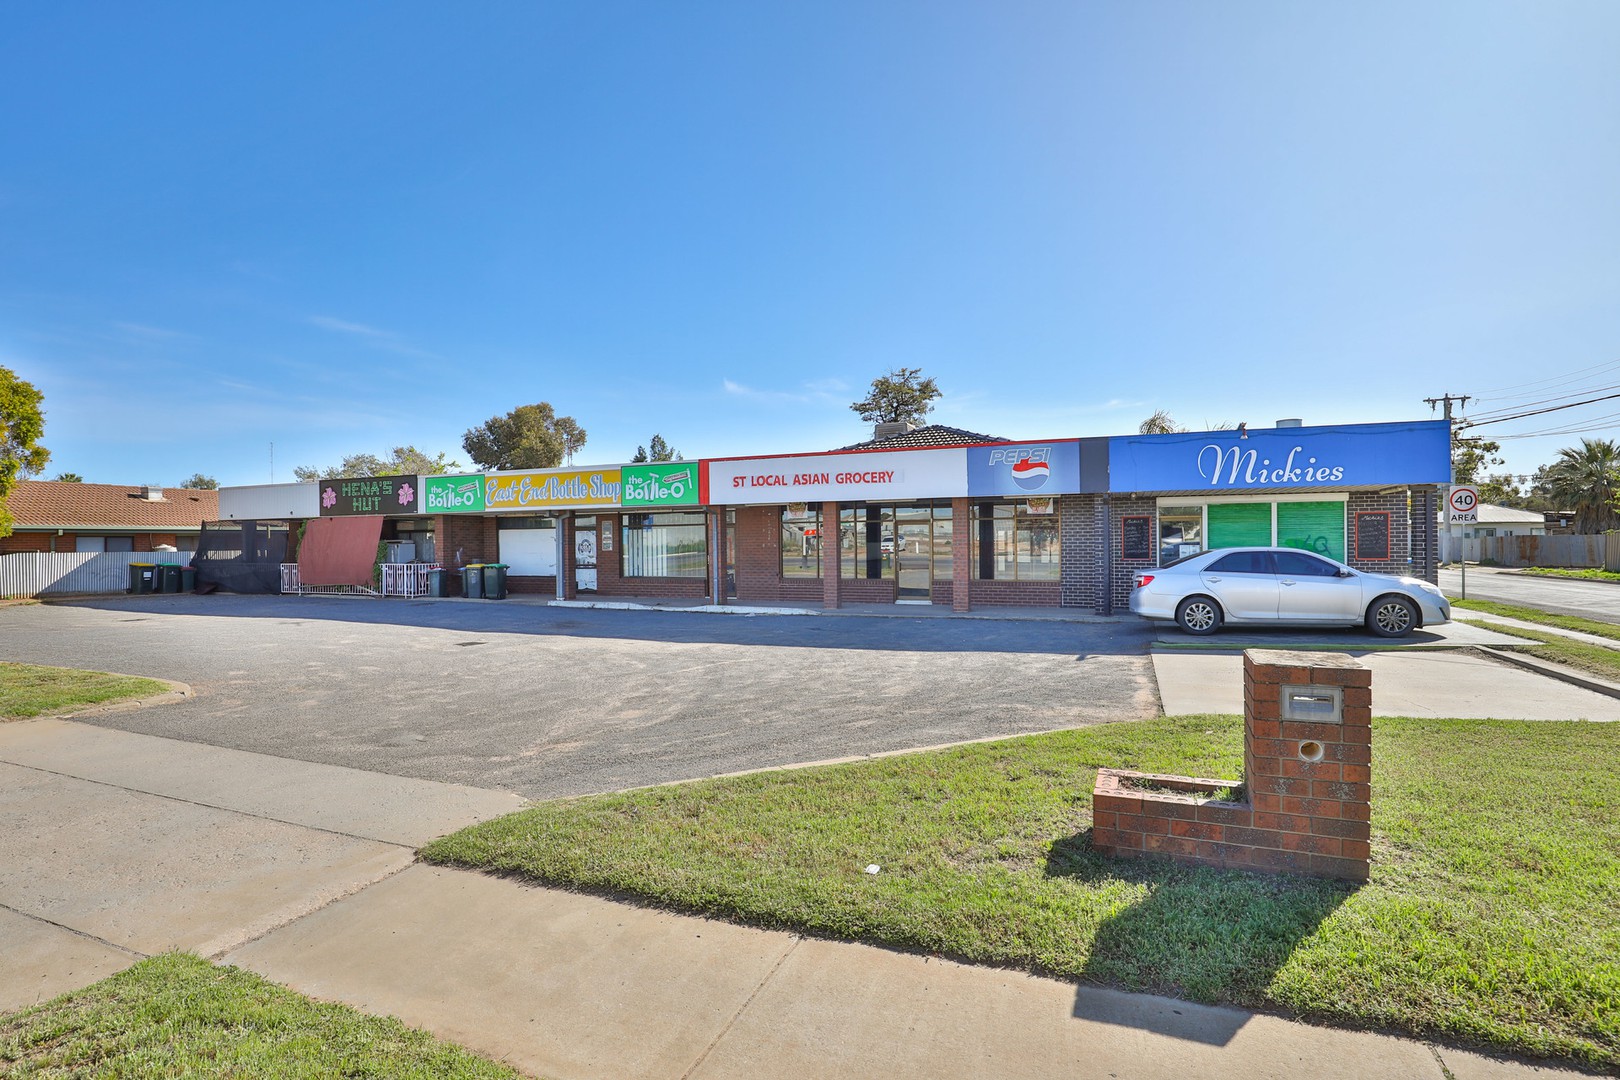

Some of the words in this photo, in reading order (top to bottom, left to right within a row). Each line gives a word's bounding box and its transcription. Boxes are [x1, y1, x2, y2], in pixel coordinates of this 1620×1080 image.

[989, 447, 1053, 466] PEPSI
[1197, 444, 1345, 485] Mickies
[628, 475, 643, 485] the
[733, 475, 746, 488] ST
[751, 474, 788, 487] LOCAL
[793, 473, 830, 486] ASIAN
[835, 470, 895, 485] GROCERY
[342, 481, 393, 496] HENA'S
[431, 485, 442, 494] the
[485, 478, 519, 504] East
[519, 476, 551, 506] End
[551, 475, 588, 500] Bottle
[589, 474, 621, 503] Shop
[352, 497, 382, 512] HUT
[1454, 494, 1473, 506] 40
[1451, 514, 1477, 522] AREA
